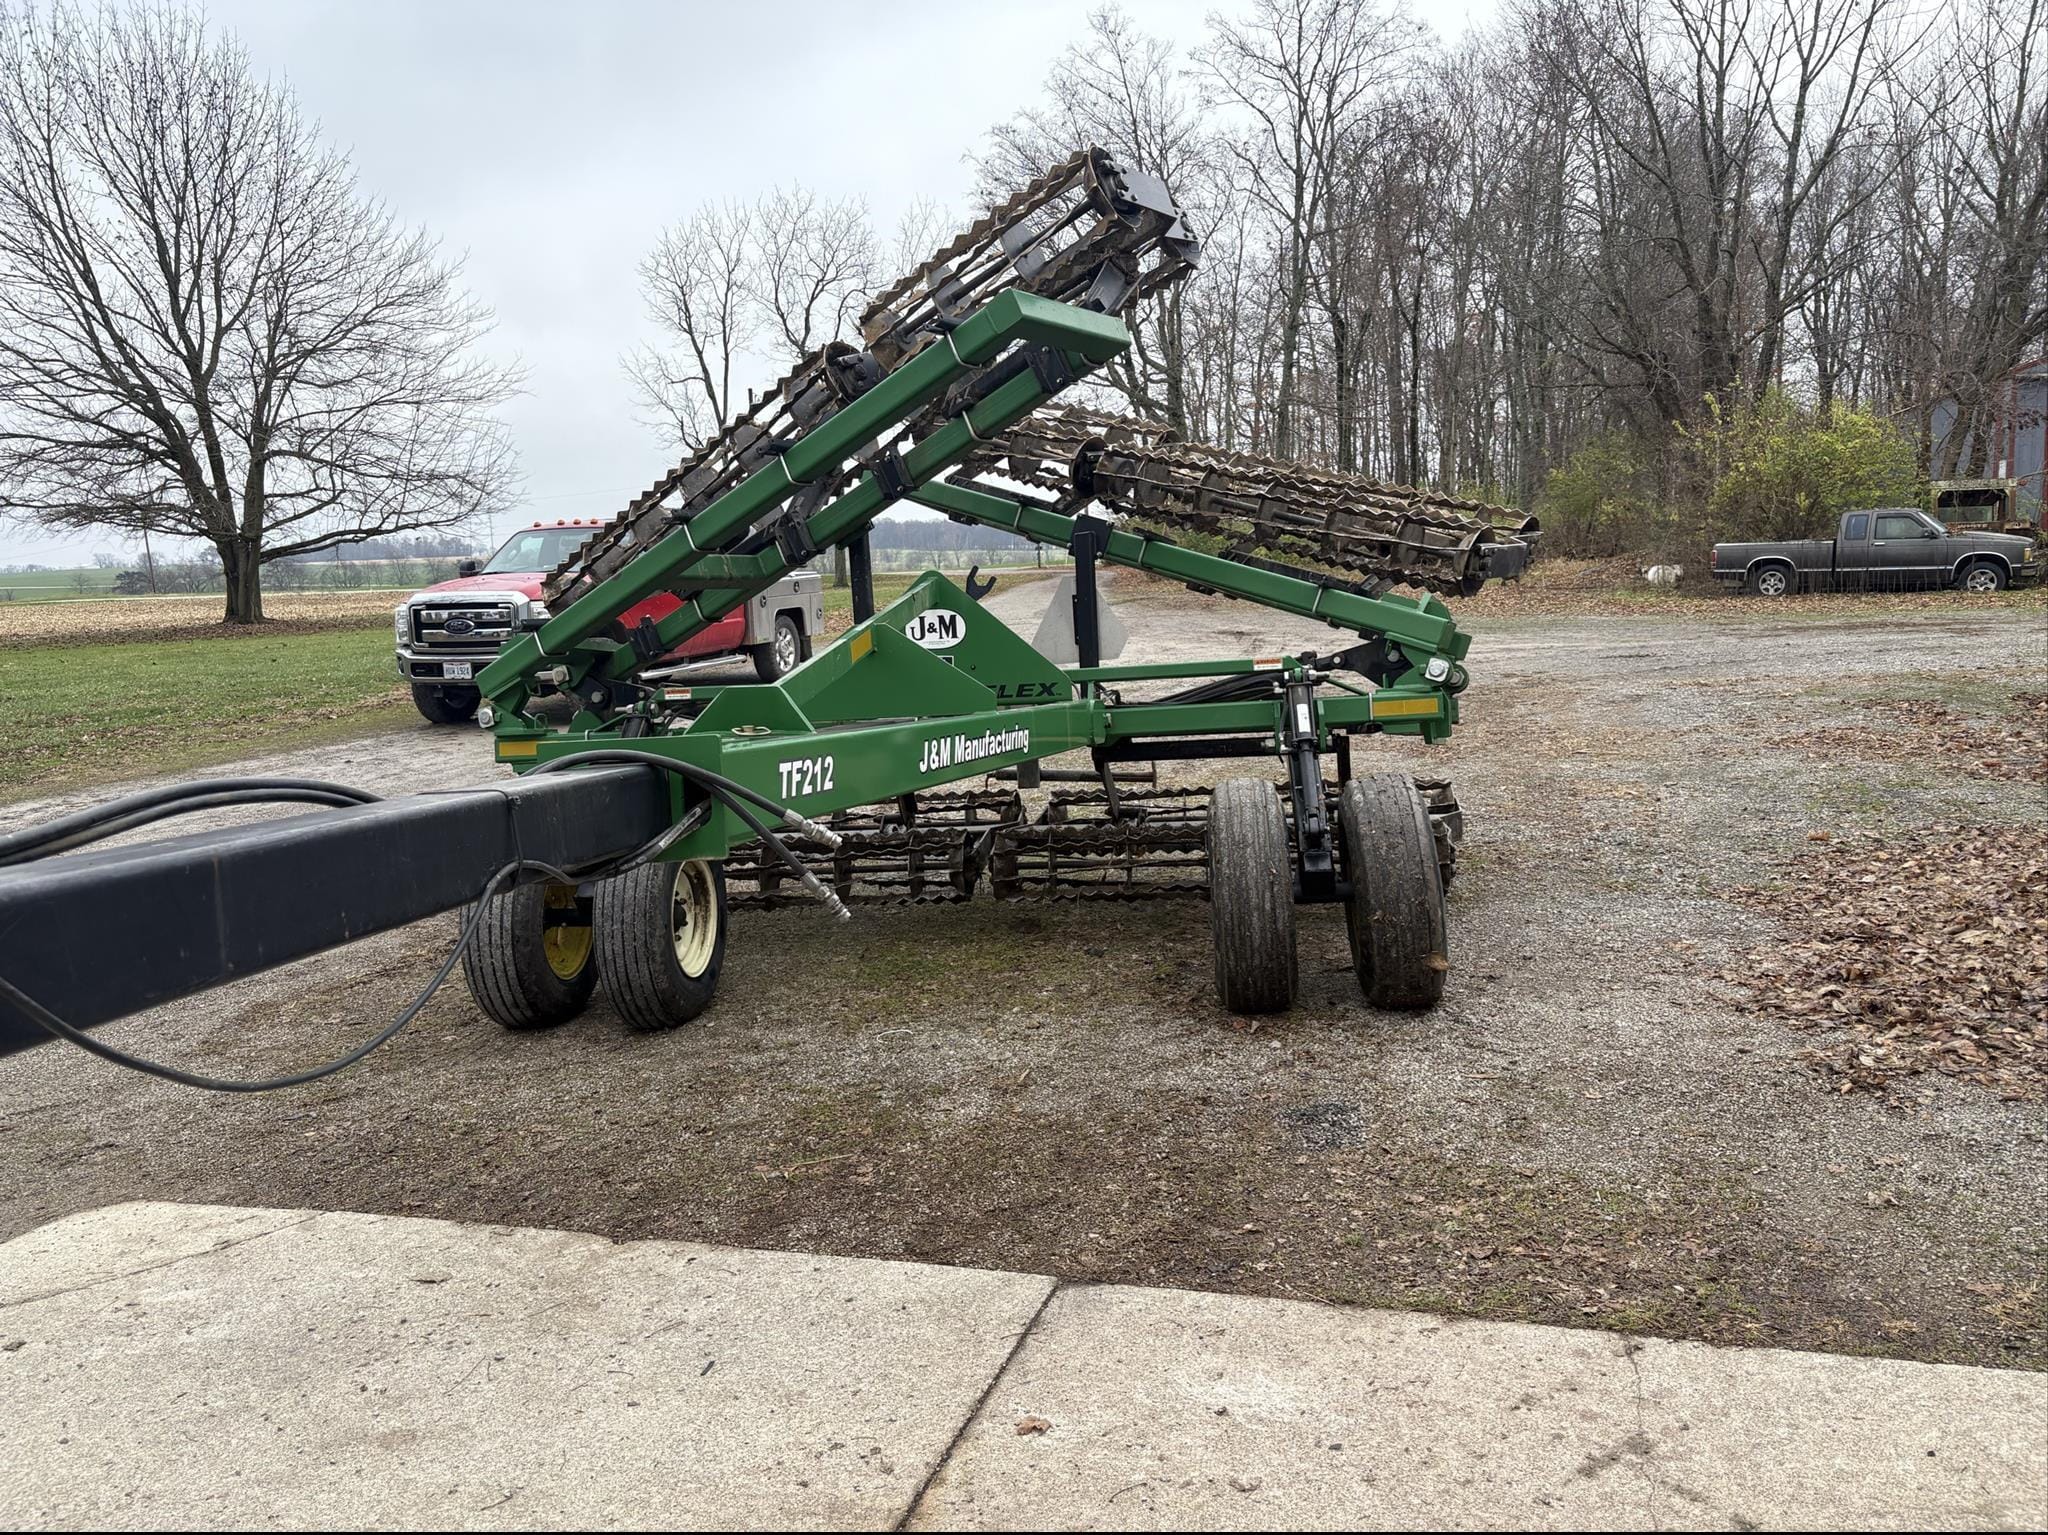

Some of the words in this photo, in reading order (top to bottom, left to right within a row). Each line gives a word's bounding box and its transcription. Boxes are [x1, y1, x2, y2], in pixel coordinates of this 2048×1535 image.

[910, 614, 959, 641] J&M
[919, 737, 951, 773] J&M
[954, 724, 1029, 764] Manufacturing
[779, 755, 834, 800] TF212
